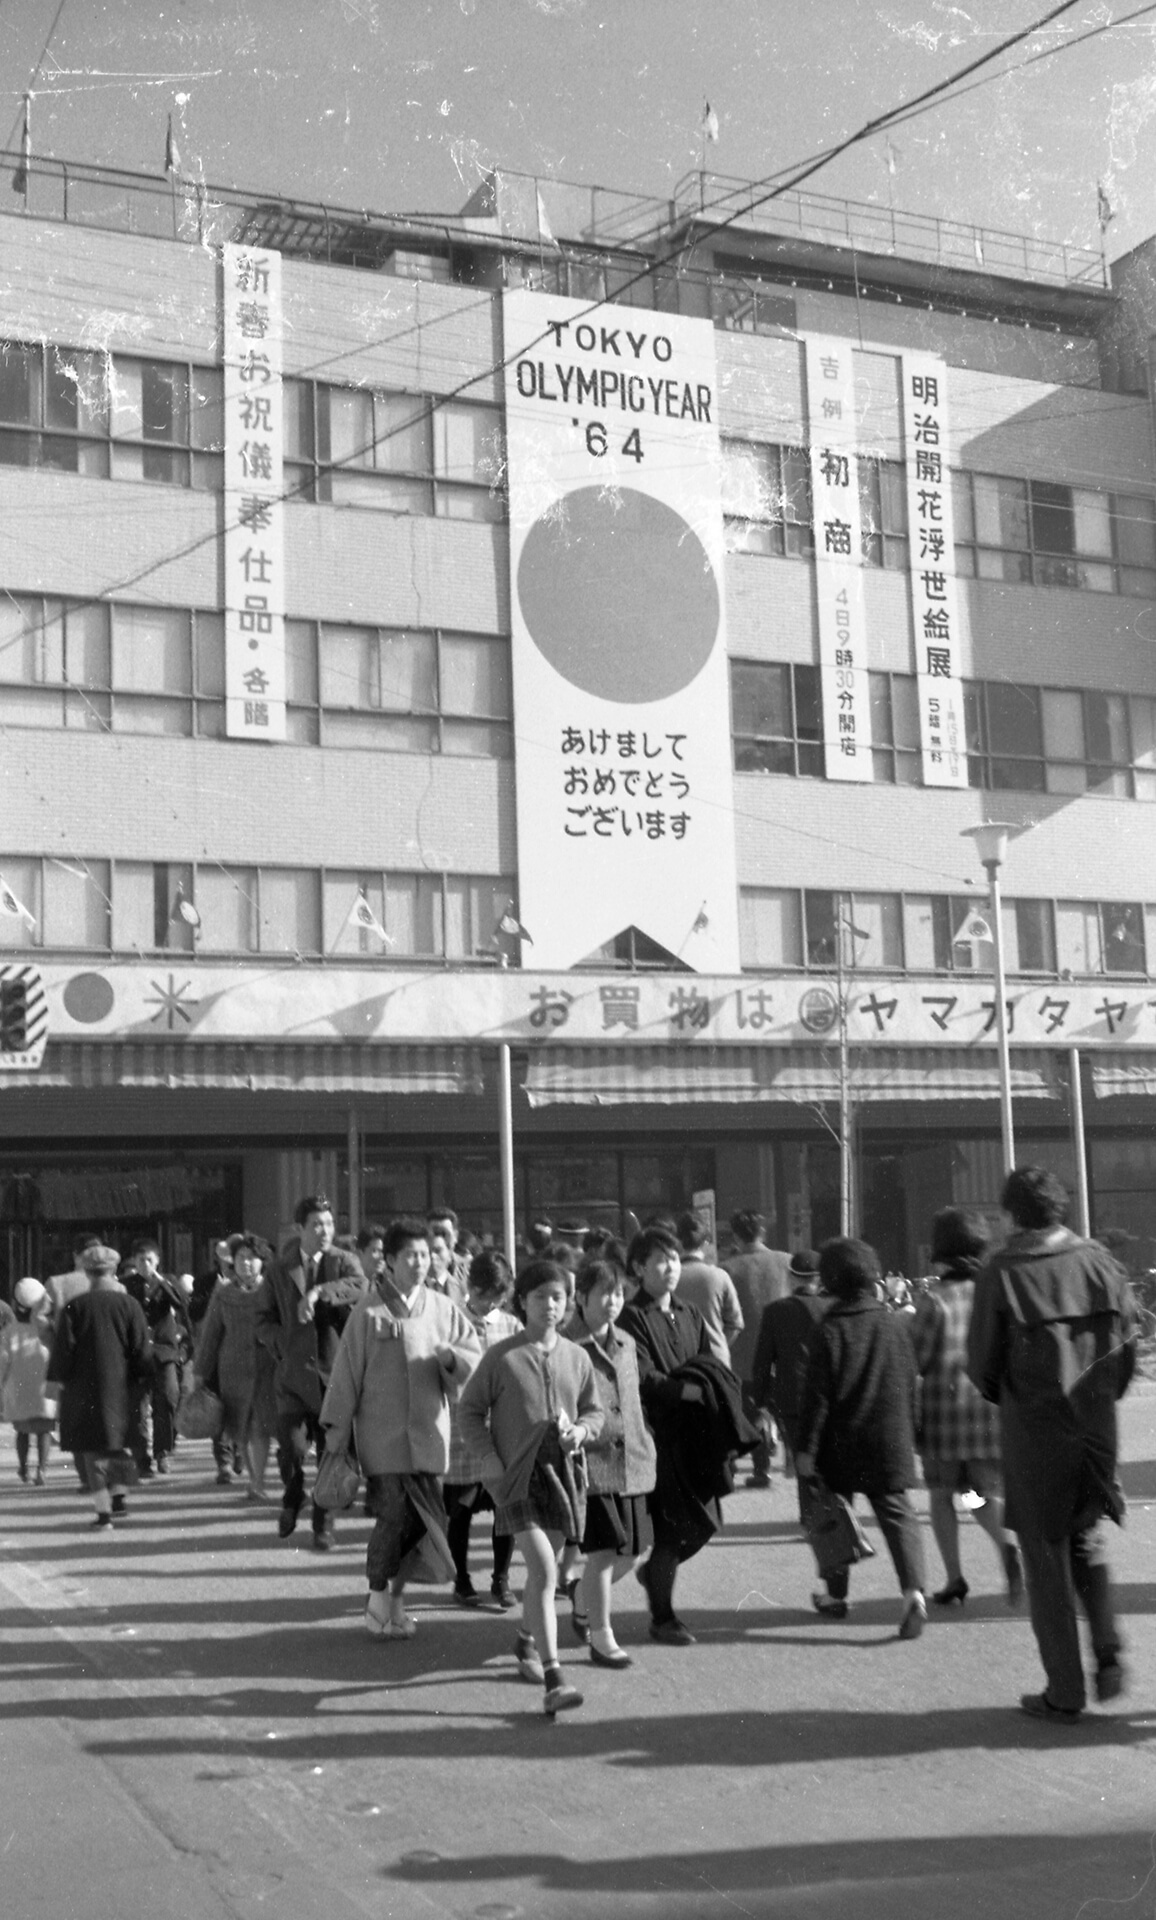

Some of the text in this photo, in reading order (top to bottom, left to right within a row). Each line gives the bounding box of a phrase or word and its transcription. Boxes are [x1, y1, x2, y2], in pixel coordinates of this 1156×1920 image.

[547, 320, 672, 362] TOKYO
[572, 418, 644, 463] '64
[912, 375, 952, 679] 明治開花浮世絵展
[561, 726, 687, 761] あけまして
[563, 766, 690, 800] おめでとう
[564, 805, 691, 840] ございます
[529, 985, 773, 1031] お買物は
[860, 993, 1156, 1035] ヤマカタヤ
